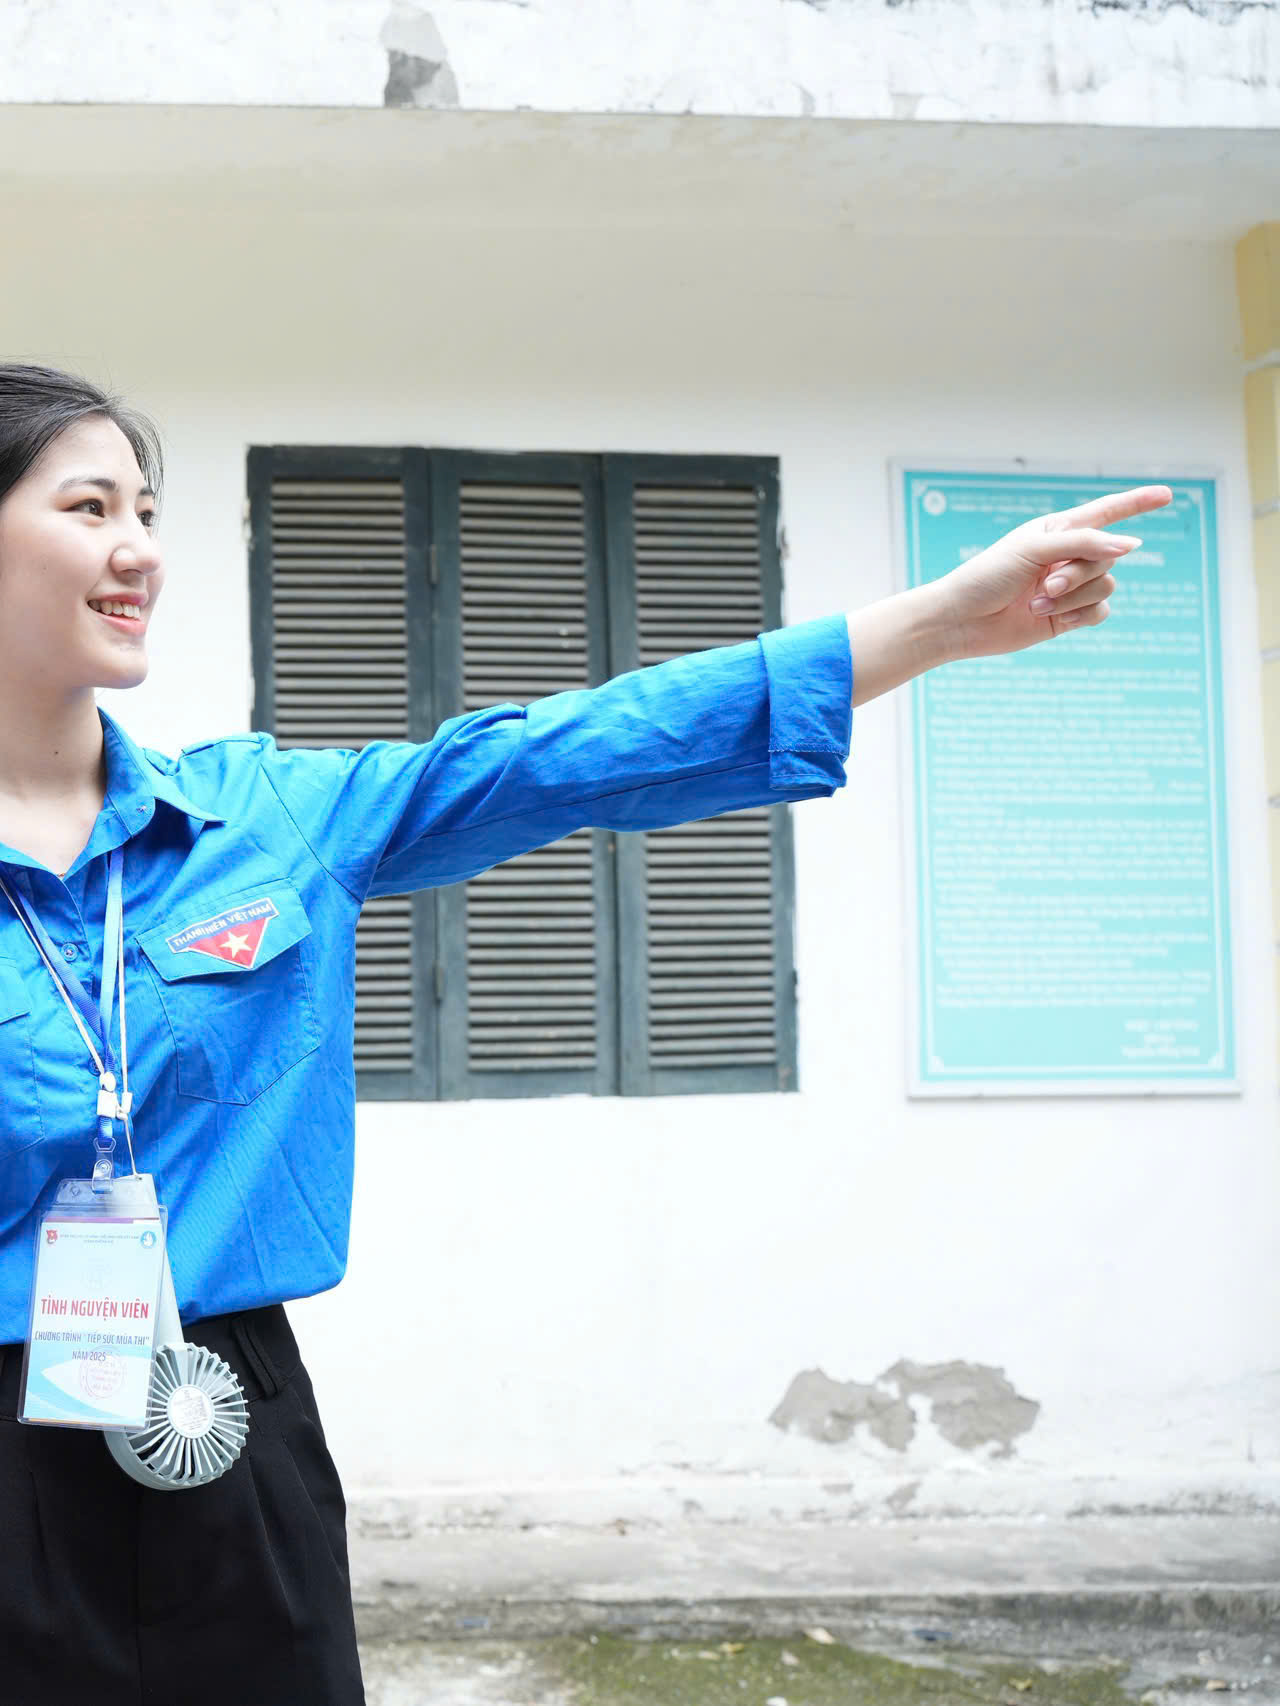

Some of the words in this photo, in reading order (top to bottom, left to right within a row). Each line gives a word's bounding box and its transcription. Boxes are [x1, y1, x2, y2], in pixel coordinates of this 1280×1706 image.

[249, 903, 272, 917] NAM
[41, 1295, 68, 1315] TÌNH
[70, 1297, 118, 1321] NGUYỆN
[122, 1298, 149, 1319] VIÊN
[89, 1351, 106, 1362] 2025
